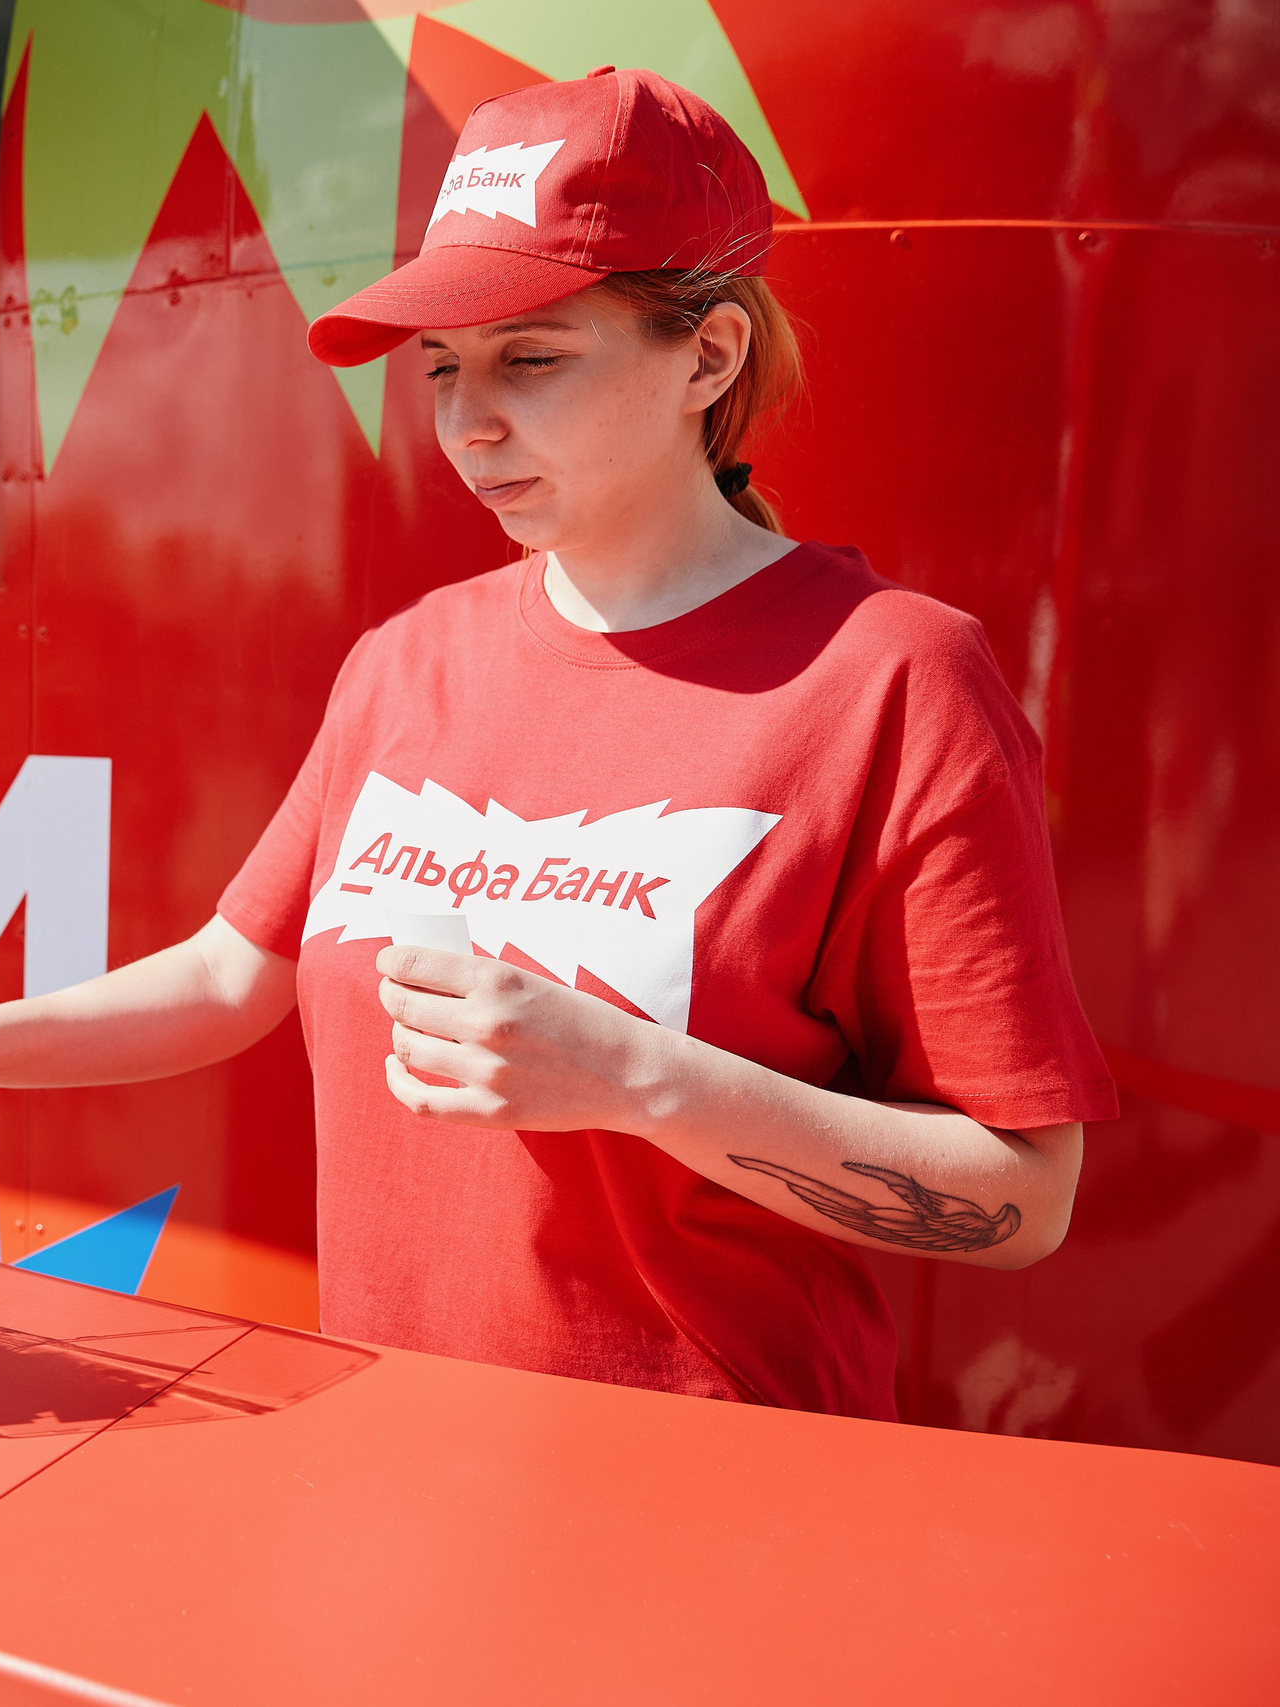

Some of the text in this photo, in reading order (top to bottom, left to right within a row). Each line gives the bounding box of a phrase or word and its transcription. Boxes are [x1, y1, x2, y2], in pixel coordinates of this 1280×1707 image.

[467, 166, 526, 188] Банк
[342, 832, 671, 921] Альфа Банк
